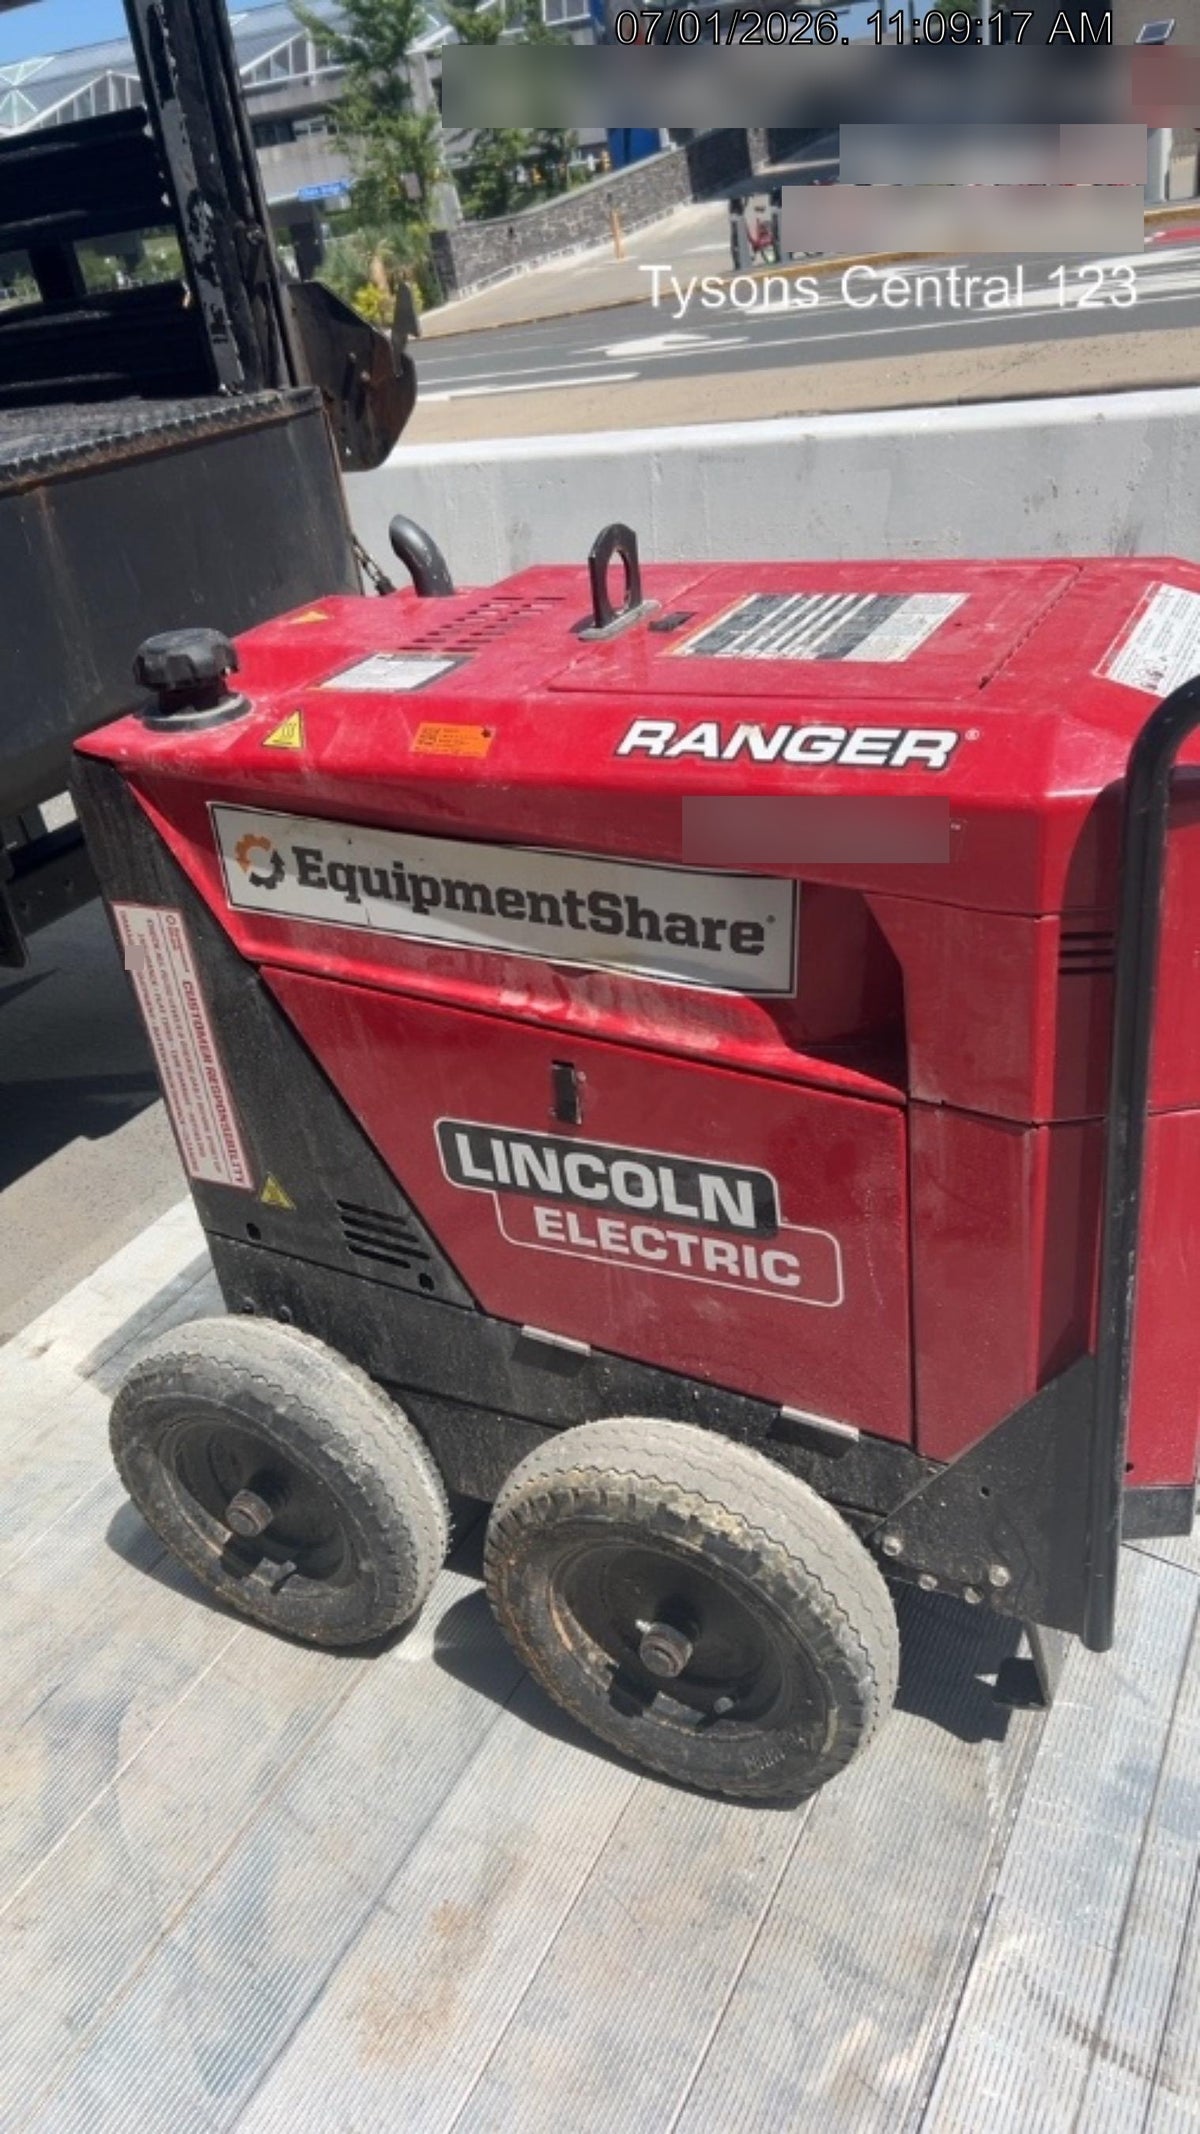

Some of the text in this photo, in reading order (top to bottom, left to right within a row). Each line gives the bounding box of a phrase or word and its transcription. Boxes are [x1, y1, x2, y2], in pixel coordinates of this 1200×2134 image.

[290, 846, 767, 957] EquipmentShare
[182, 981, 244, 1182] CUSTOMER RESPONSIBILITY
[455, 1132, 757, 1229] LINCOLN
[533, 1206, 801, 1288] ELECTRIC
